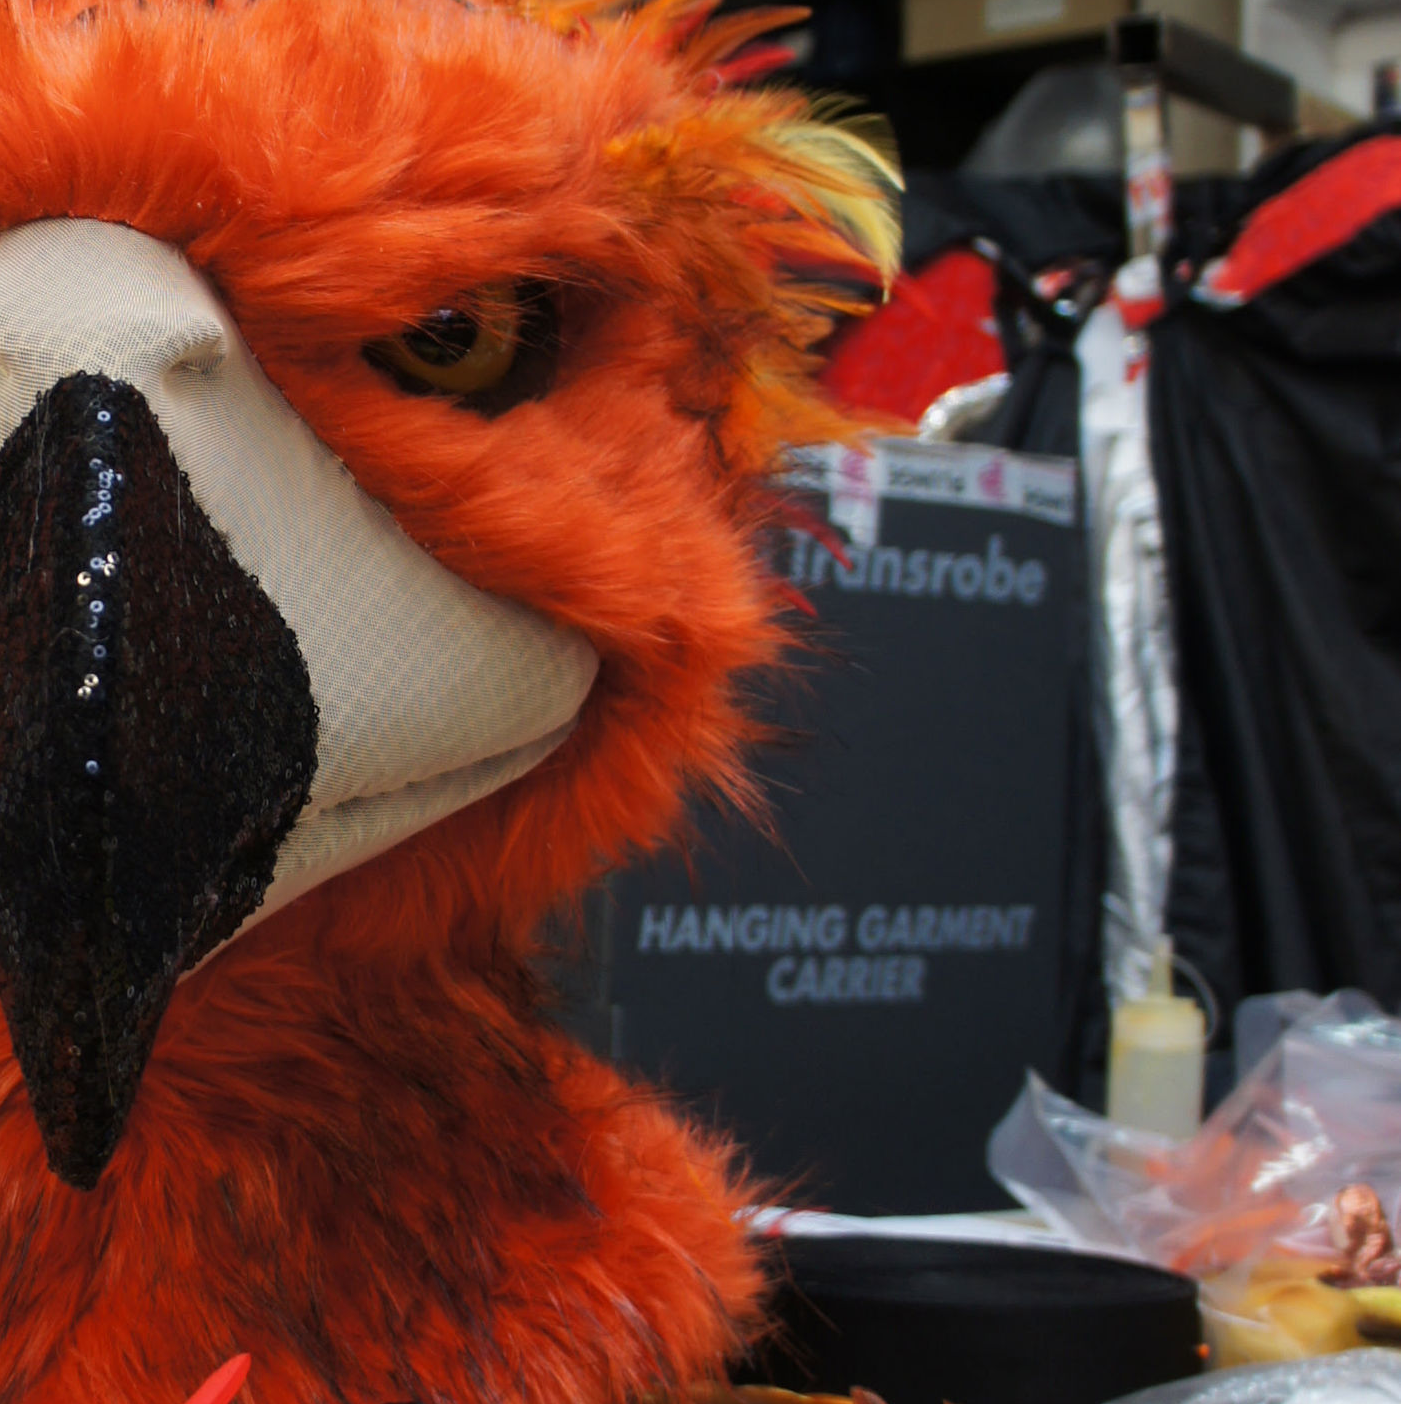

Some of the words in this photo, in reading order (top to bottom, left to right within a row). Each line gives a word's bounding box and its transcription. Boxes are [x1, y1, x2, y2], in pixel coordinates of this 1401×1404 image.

[787, 528, 1047, 606] Transrobe
[638, 903, 848, 953] HANGING
[856, 903, 1035, 950] GARMENT
[766, 955, 928, 1005] CARRIER
